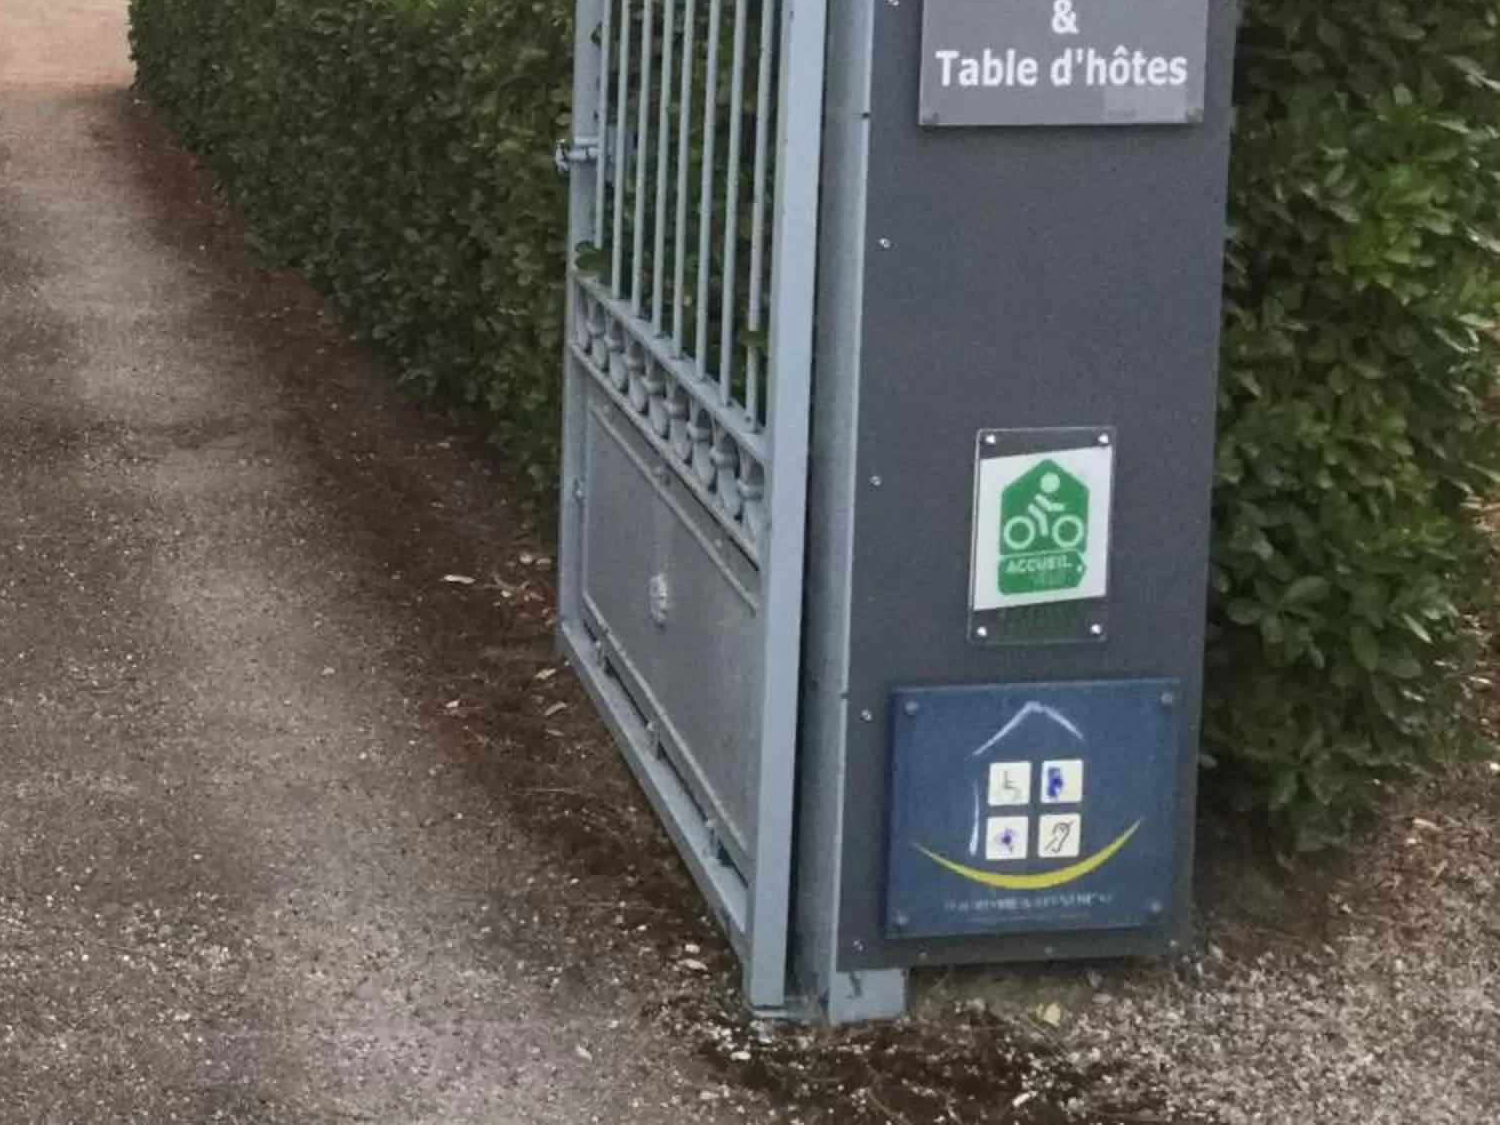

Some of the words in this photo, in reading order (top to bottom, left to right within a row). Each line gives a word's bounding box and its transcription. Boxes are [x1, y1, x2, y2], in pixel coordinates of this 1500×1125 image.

[935, 48, 1039, 87] Table
[1049, 44, 1189, 87] d'hôtes
[1006, 555, 1072, 573] ACCUEIL
